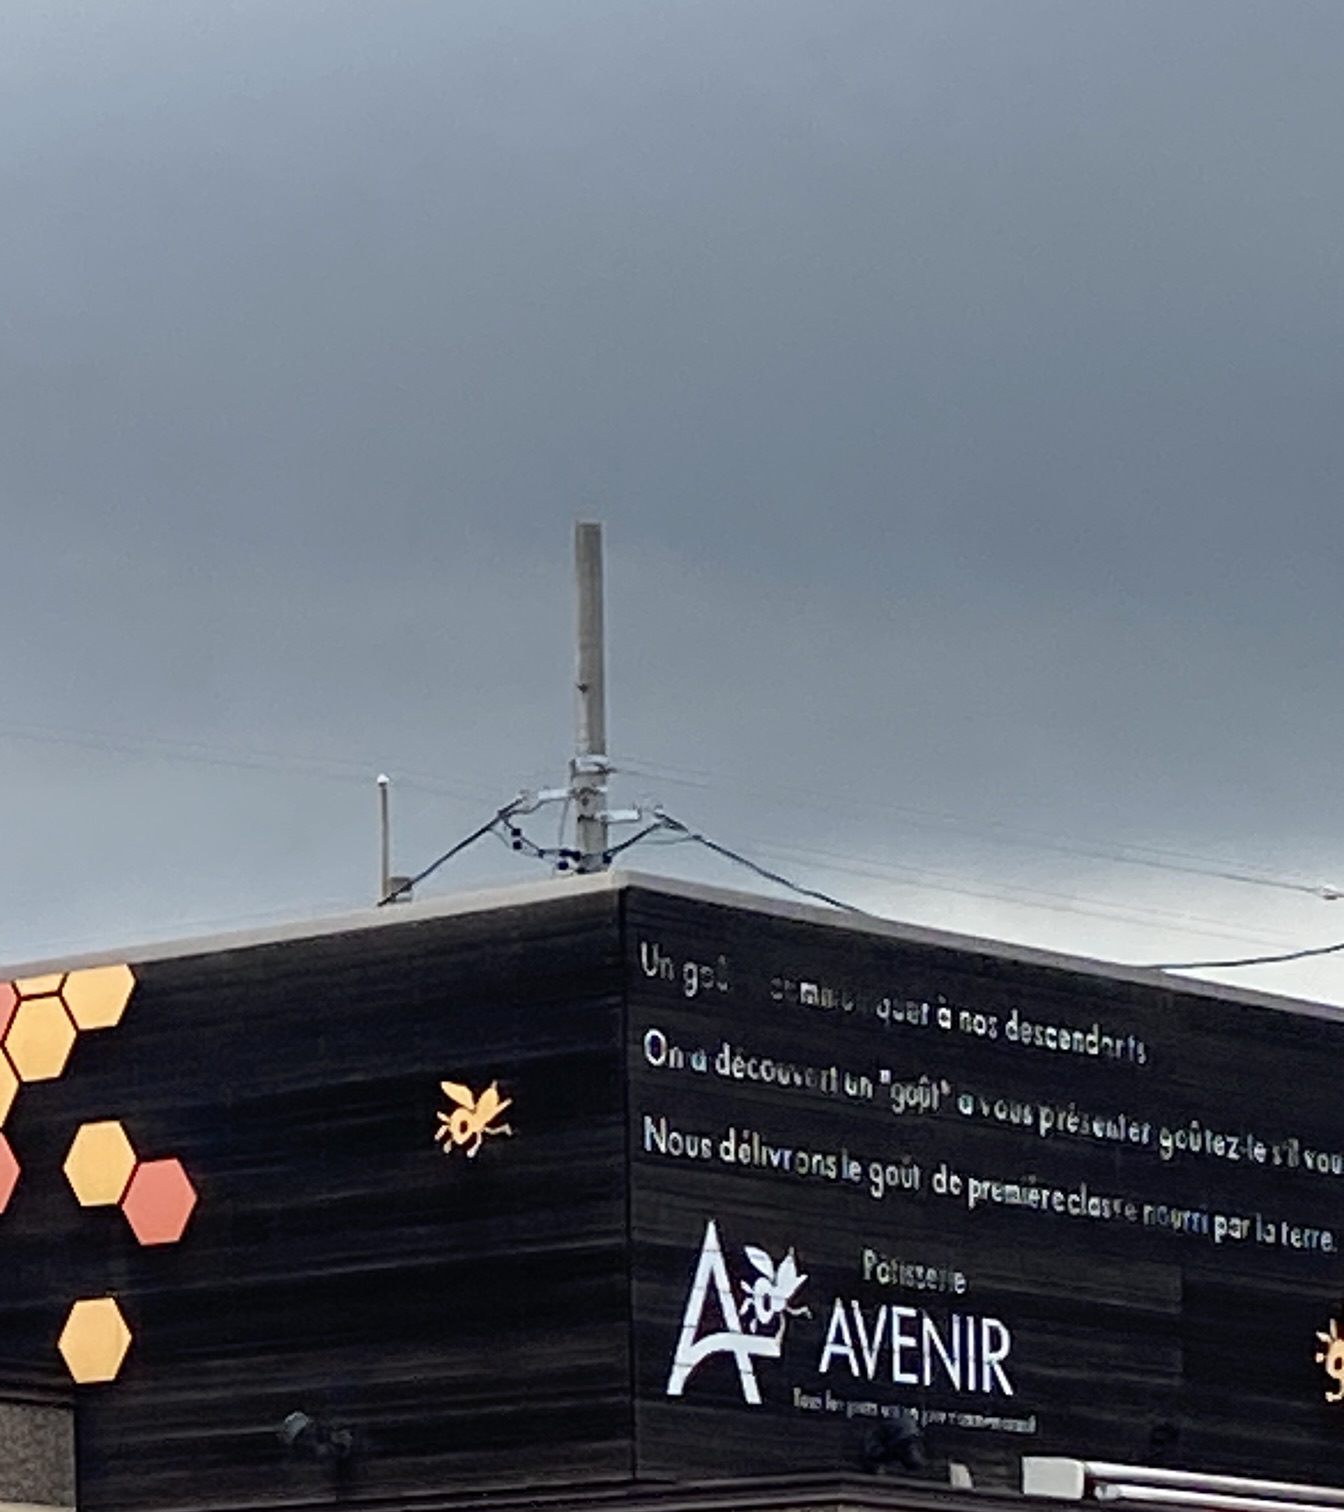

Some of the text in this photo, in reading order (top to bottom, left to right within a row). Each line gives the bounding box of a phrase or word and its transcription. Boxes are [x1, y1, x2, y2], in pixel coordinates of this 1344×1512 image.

[641, 942, 674, 980] Un
[960, 1010, 998, 1039] nos
[644, 1028, 683, 1068] On
[844, 1072, 873, 1098] un
[980, 1097, 1033, 1127] vous
[644, 1115, 711, 1158] Nous
[719, 1127, 836, 1179] délivrons
[842, 1149, 861, 1181] le
[932, 1164, 961, 1196] de
[1214, 1215, 1250, 1243] par
[1256, 1213, 1276, 1243] la
[818, 1297, 1013, 1396] AVENIR
